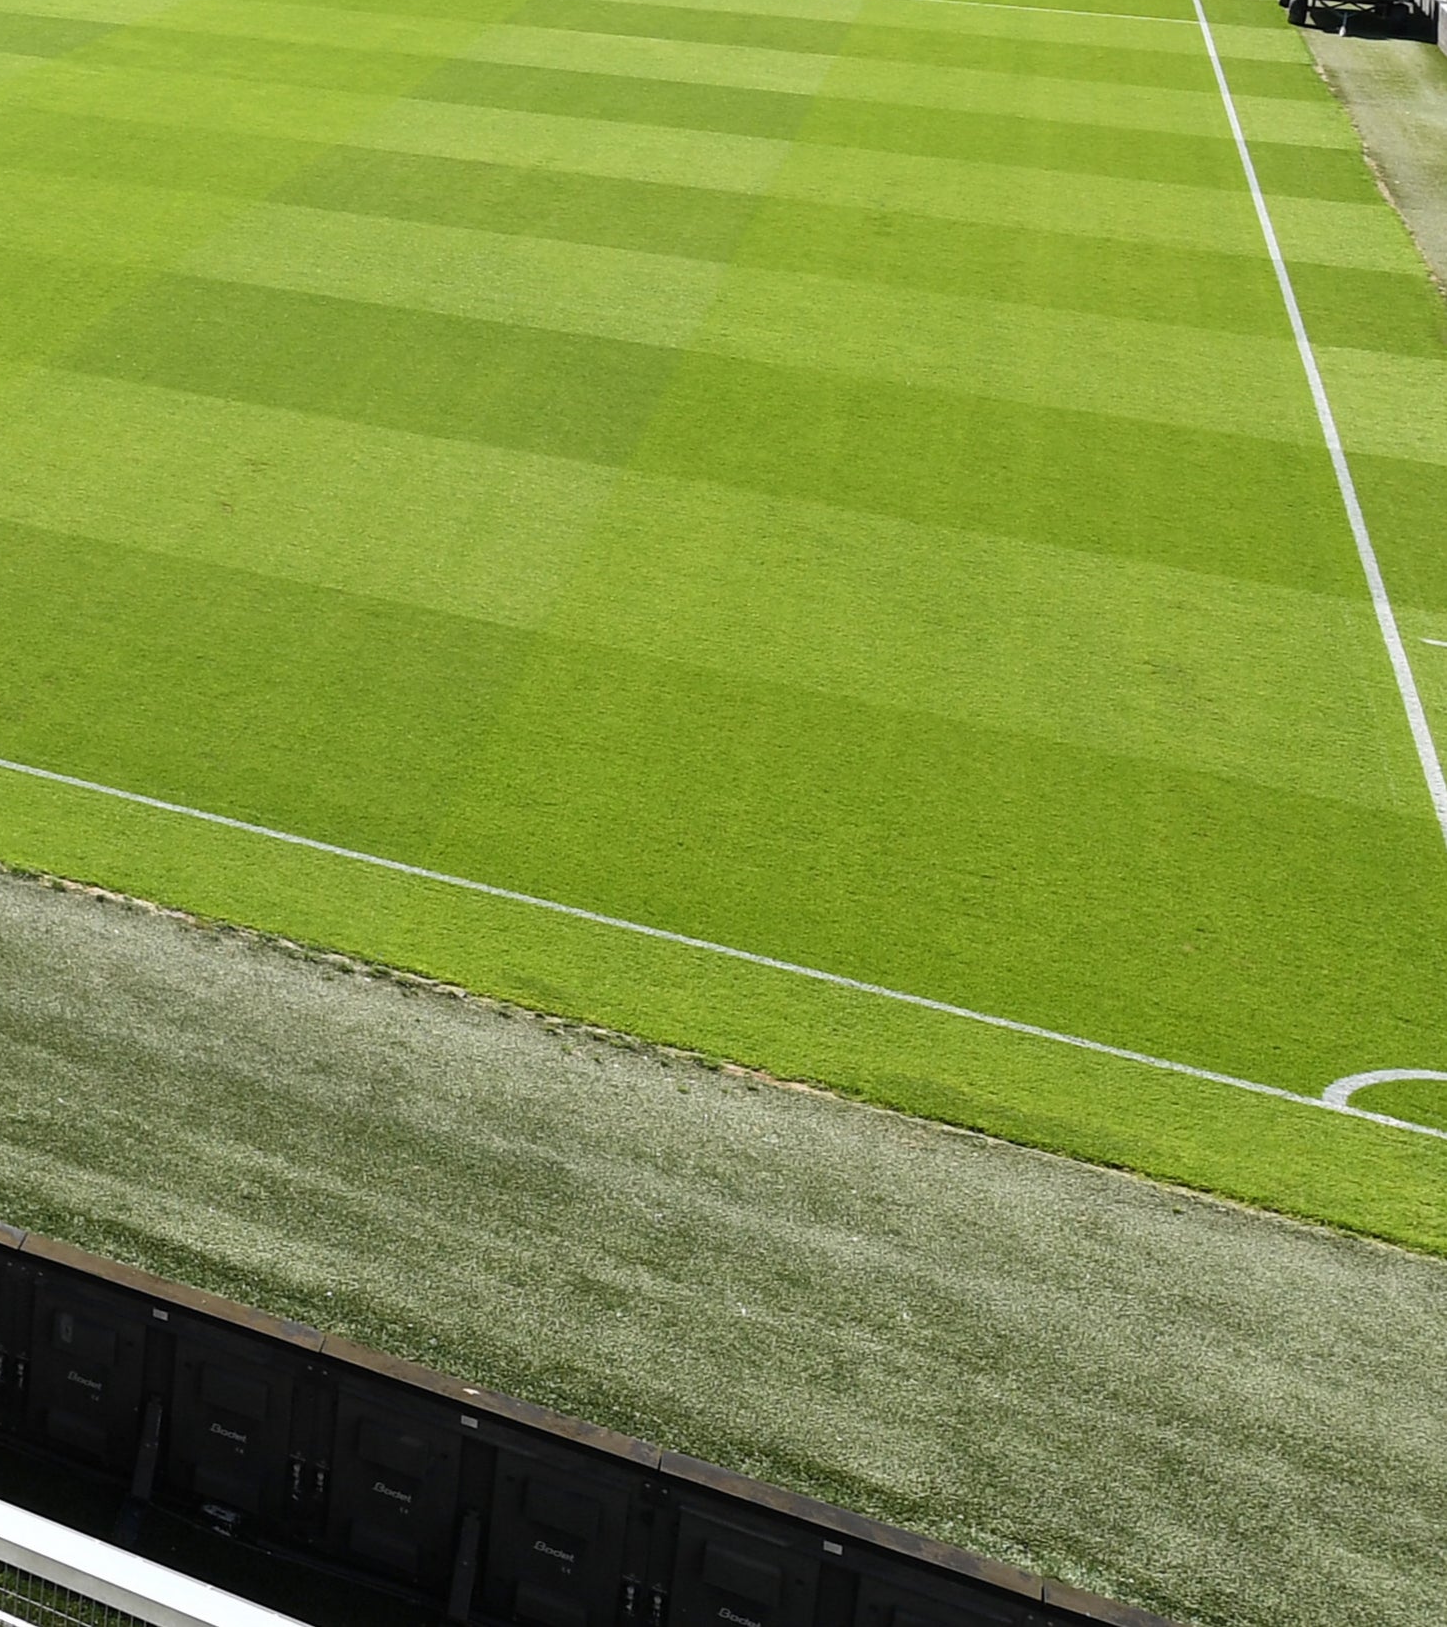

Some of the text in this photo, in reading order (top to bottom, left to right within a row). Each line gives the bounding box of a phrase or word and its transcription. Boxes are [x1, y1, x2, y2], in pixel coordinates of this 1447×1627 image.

[67, 1370, 103, 1392] Bodet
[210, 1422, 248, 1445] Bodet
[372, 1481, 412, 1504] Bodet
[534, 1540, 575, 1563] Bodet
